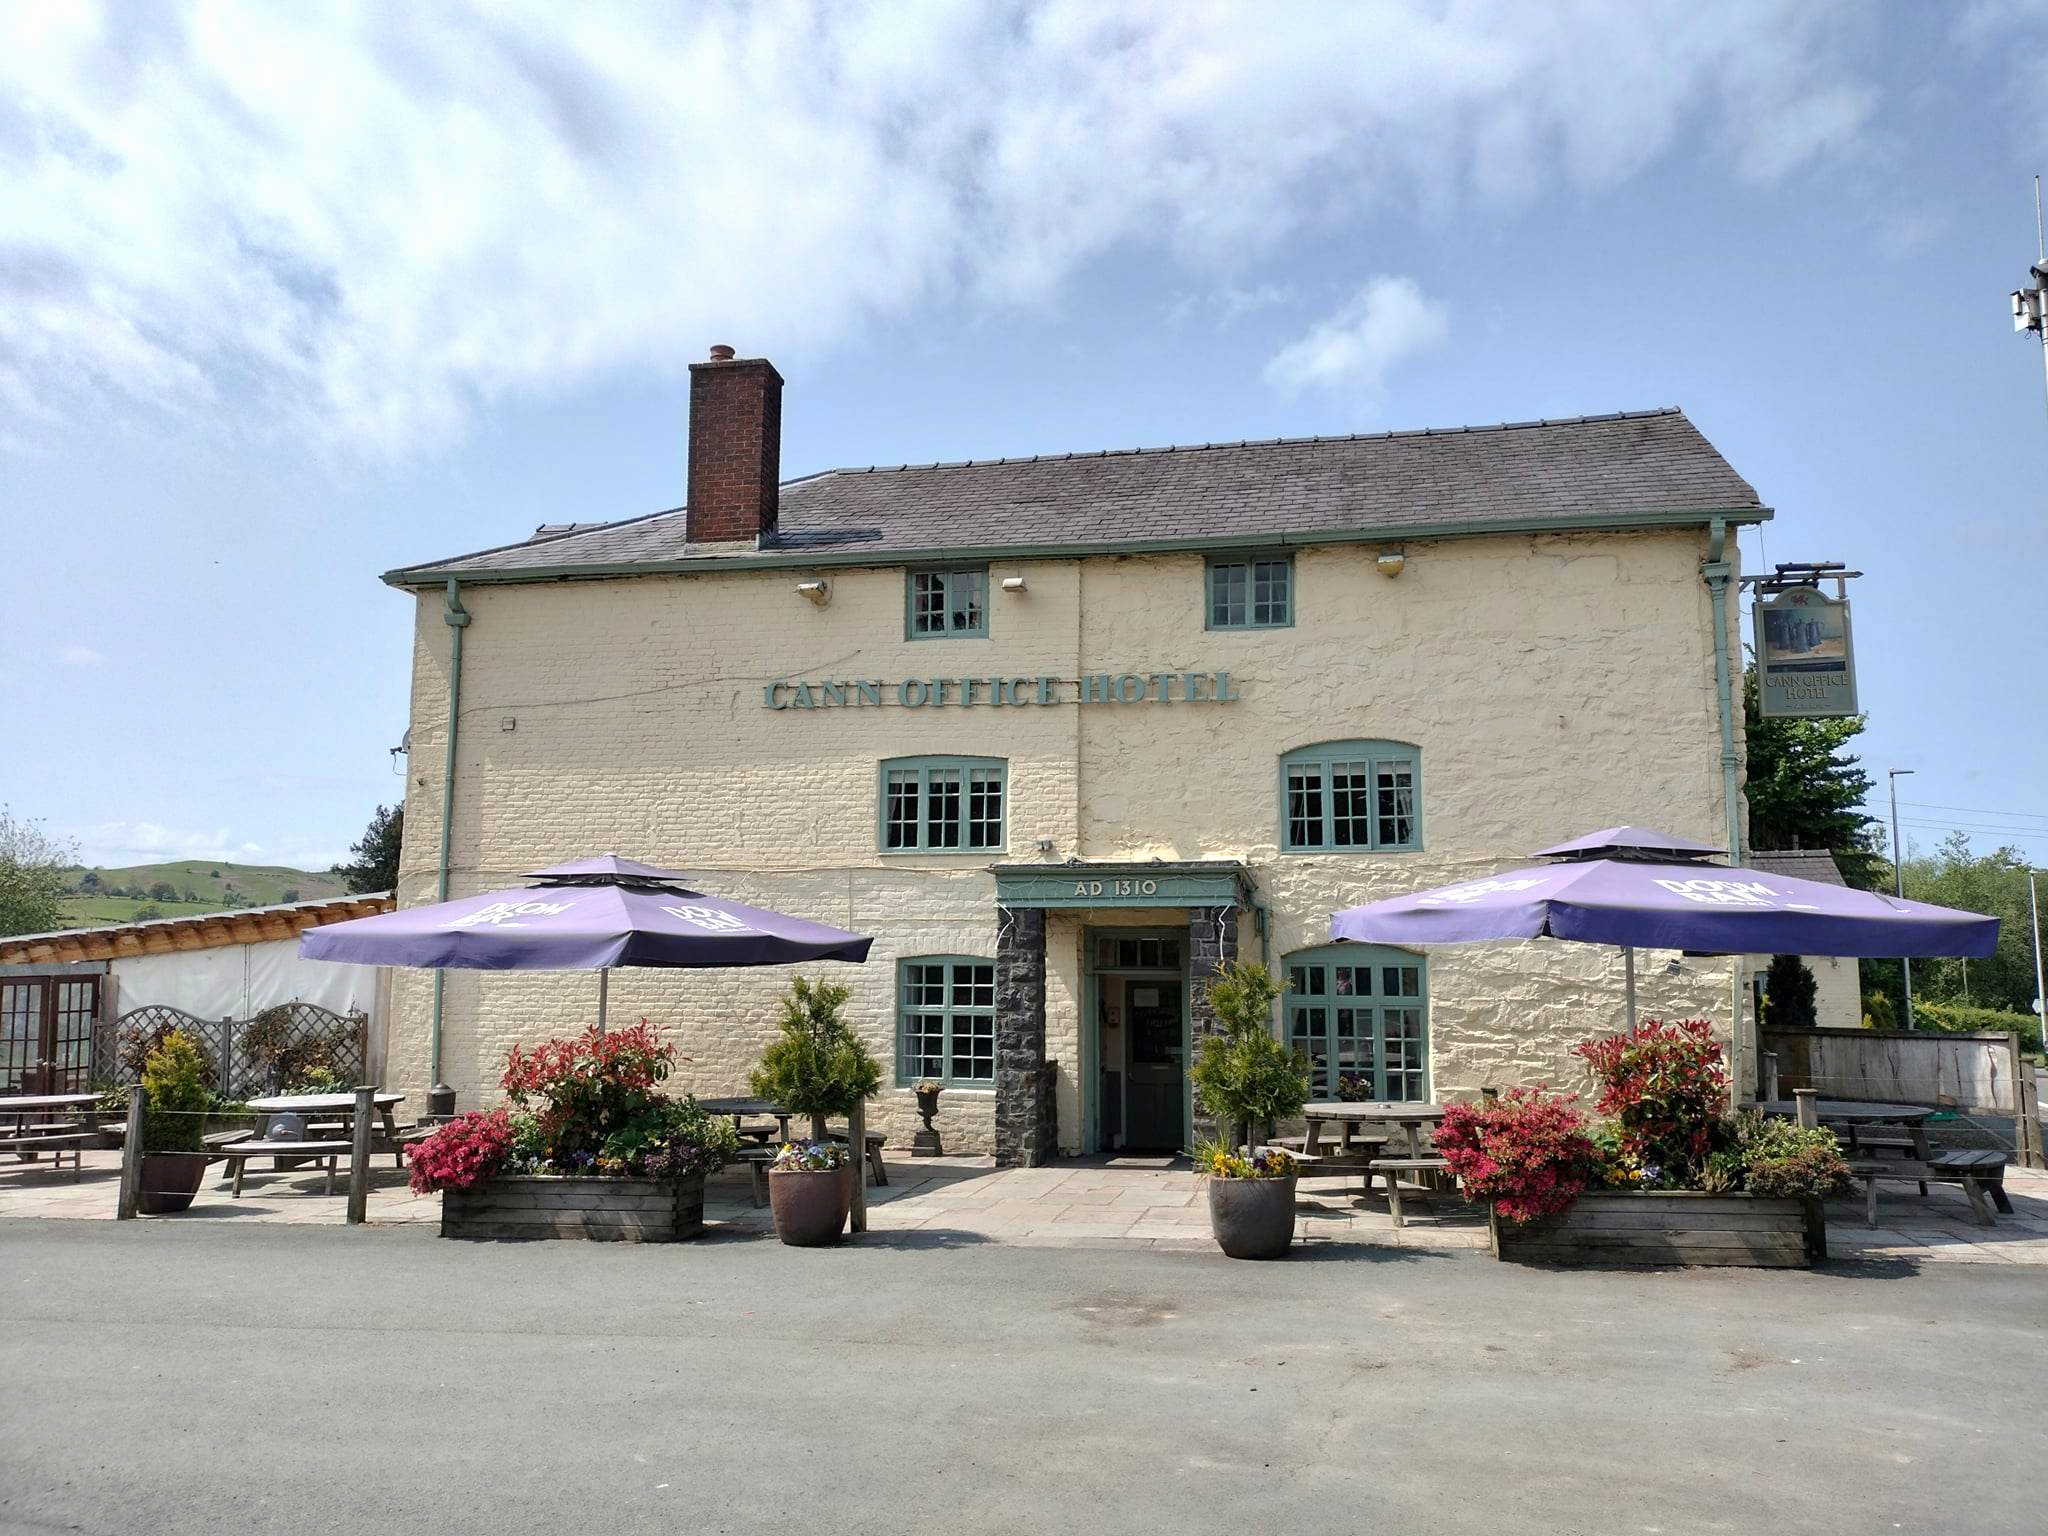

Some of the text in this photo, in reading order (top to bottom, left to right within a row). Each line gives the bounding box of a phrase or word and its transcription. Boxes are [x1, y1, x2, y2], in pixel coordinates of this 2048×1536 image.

[1765, 672, 1849, 688] CANN OFFICE
[763, 672, 1240, 710] CANN OFFICE HOTEL
[1785, 687, 1830, 700] HOTEL
[1074, 880, 1157, 896] AD 1310
